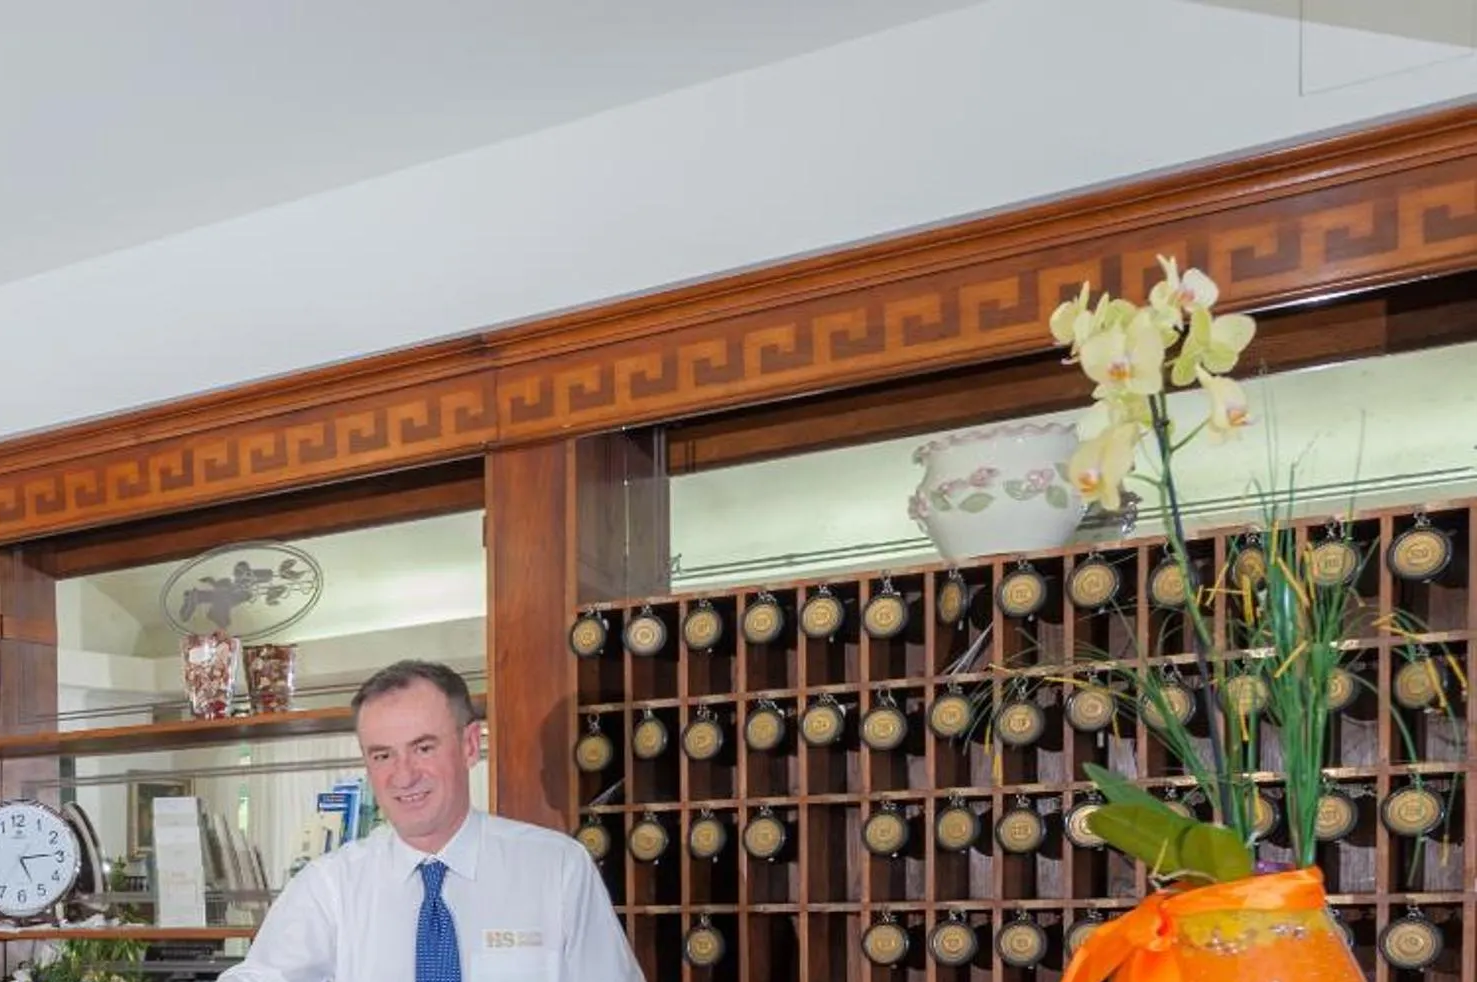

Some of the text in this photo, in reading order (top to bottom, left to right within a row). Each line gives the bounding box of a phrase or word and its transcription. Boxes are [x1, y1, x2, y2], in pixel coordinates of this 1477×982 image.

[11, 815, 26, 828] 12
[37, 819, 42, 832] 1
[49, 831, 59, 845] 2
[54, 850, 65, 864] 3
[51, 870, 60, 882] 4
[17, 890, 27, 903] 6
[37, 884, 47, 897] 5
